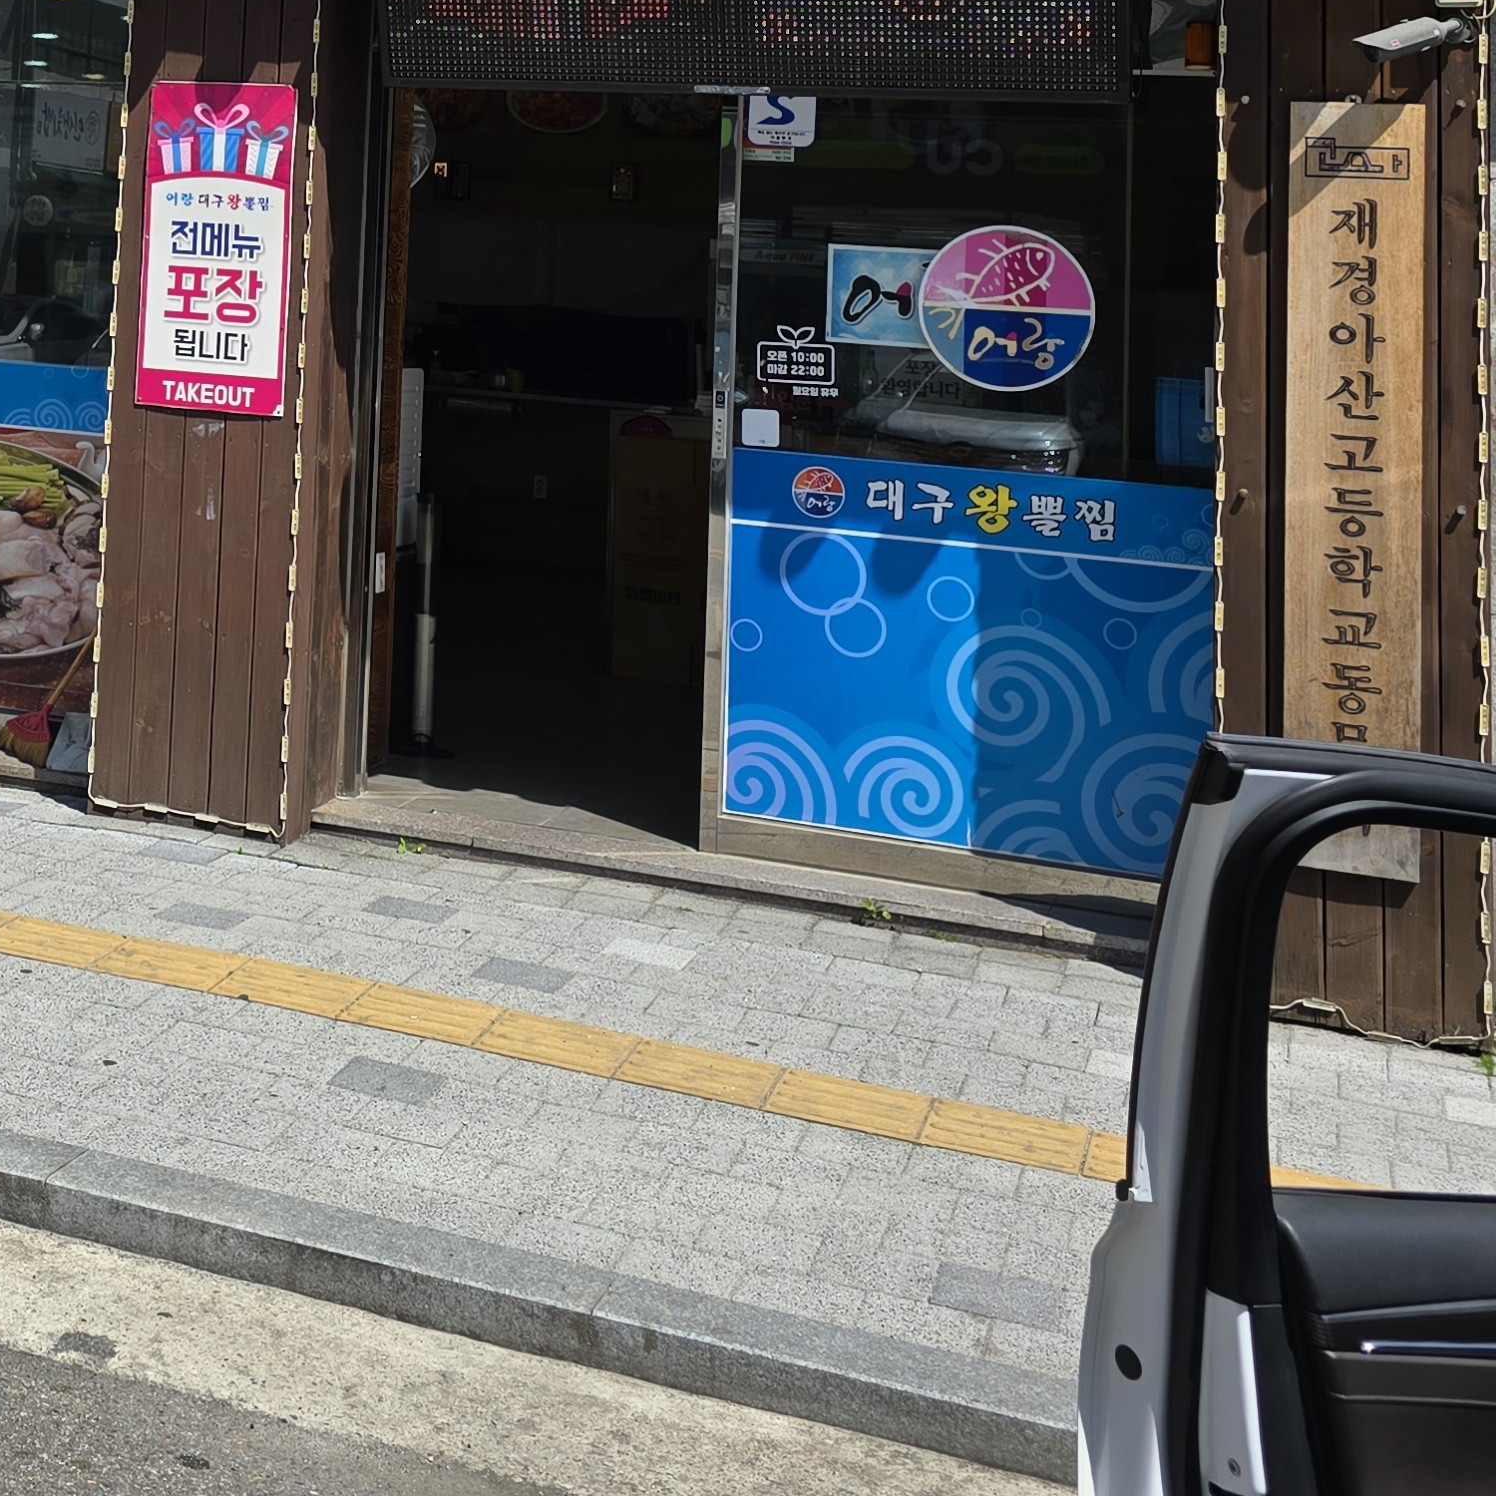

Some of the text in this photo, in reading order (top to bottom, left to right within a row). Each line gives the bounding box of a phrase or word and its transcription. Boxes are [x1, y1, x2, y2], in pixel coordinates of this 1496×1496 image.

[171, 220, 261, 259] 전메뉴
[164, 265, 263, 324] 포장
[174, 328, 248, 362] 됩니다
[767, 350, 825, 363] 오픈 10:00
[967, 317, 1066, 370] 어랑
[766, 363, 825, 376] 마감 22:00
[162, 379, 255, 408] TAKEOUT
[820, 387, 839, 398] 휴무
